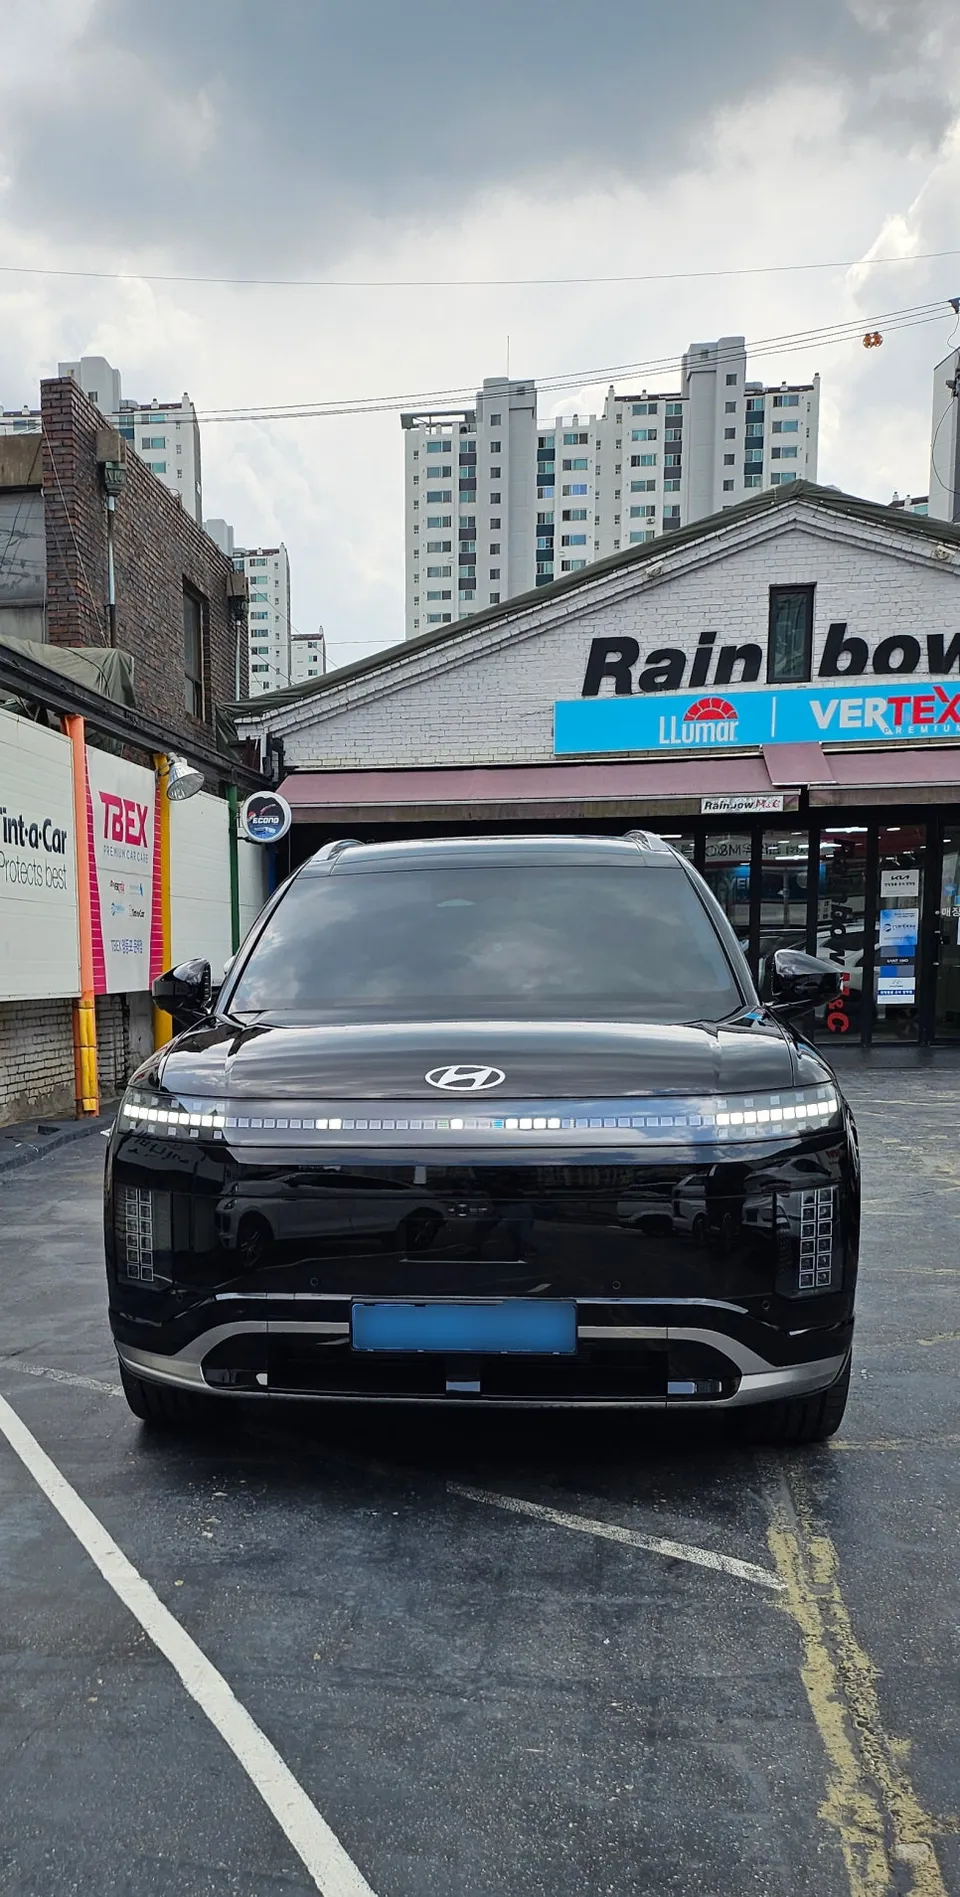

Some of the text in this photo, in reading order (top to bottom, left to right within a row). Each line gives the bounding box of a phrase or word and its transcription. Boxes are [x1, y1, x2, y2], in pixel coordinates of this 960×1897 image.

[659, 716, 739, 744] LLumar
[809, 686, 960, 735] VERTEX
[99, 791, 149, 849] TBEX
[0, 850, 67, 890] Protects best
